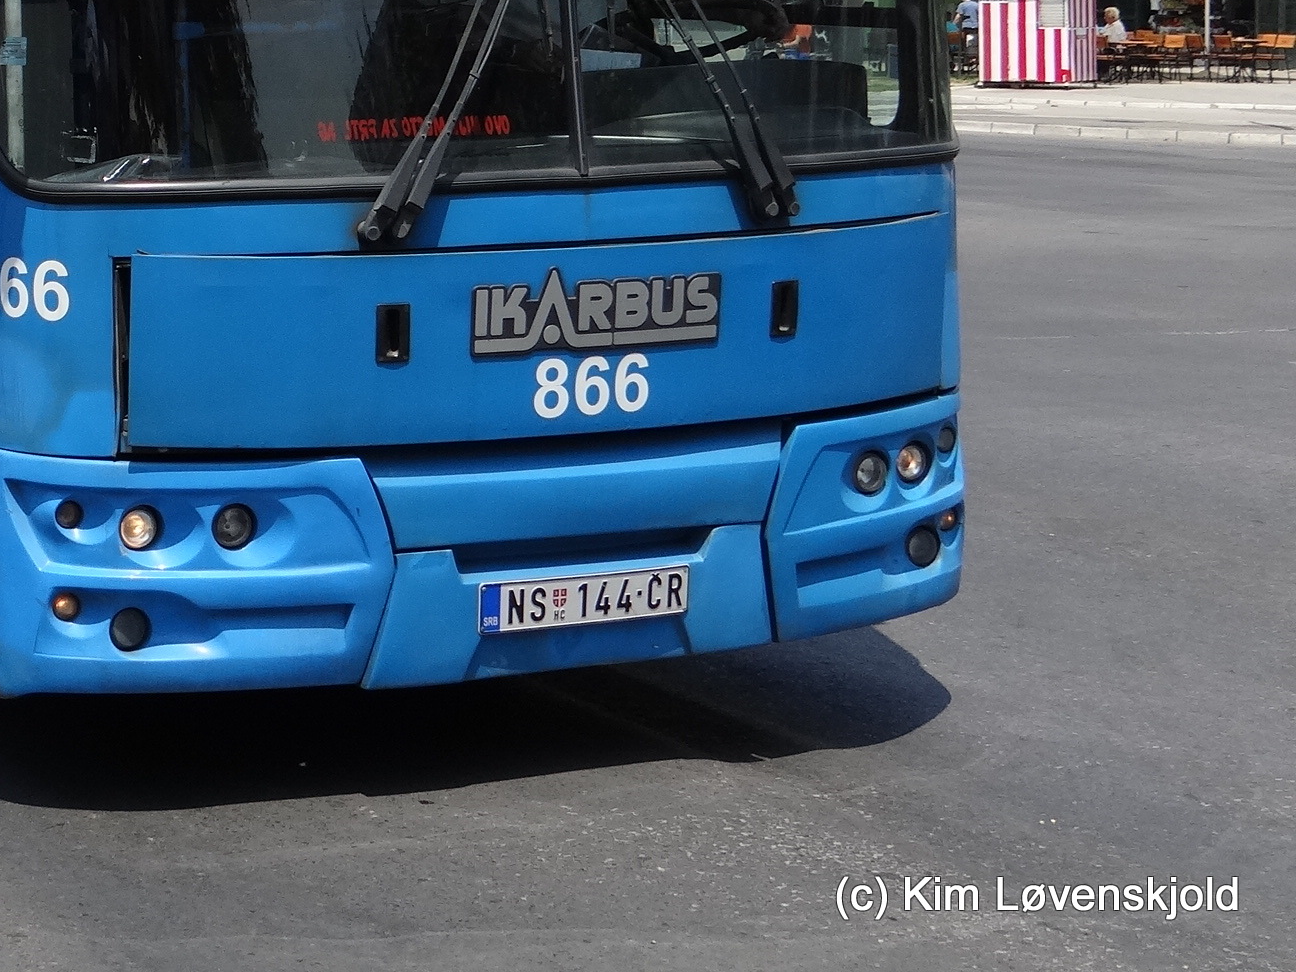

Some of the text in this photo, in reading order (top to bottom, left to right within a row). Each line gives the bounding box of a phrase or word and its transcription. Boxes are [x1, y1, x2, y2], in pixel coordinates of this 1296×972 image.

[473, 268, 720, 355] IKARBUS
[533, 352, 649, 419] 866
[483, 616, 499, 628] SRB
[507, 587, 547, 625] NS
